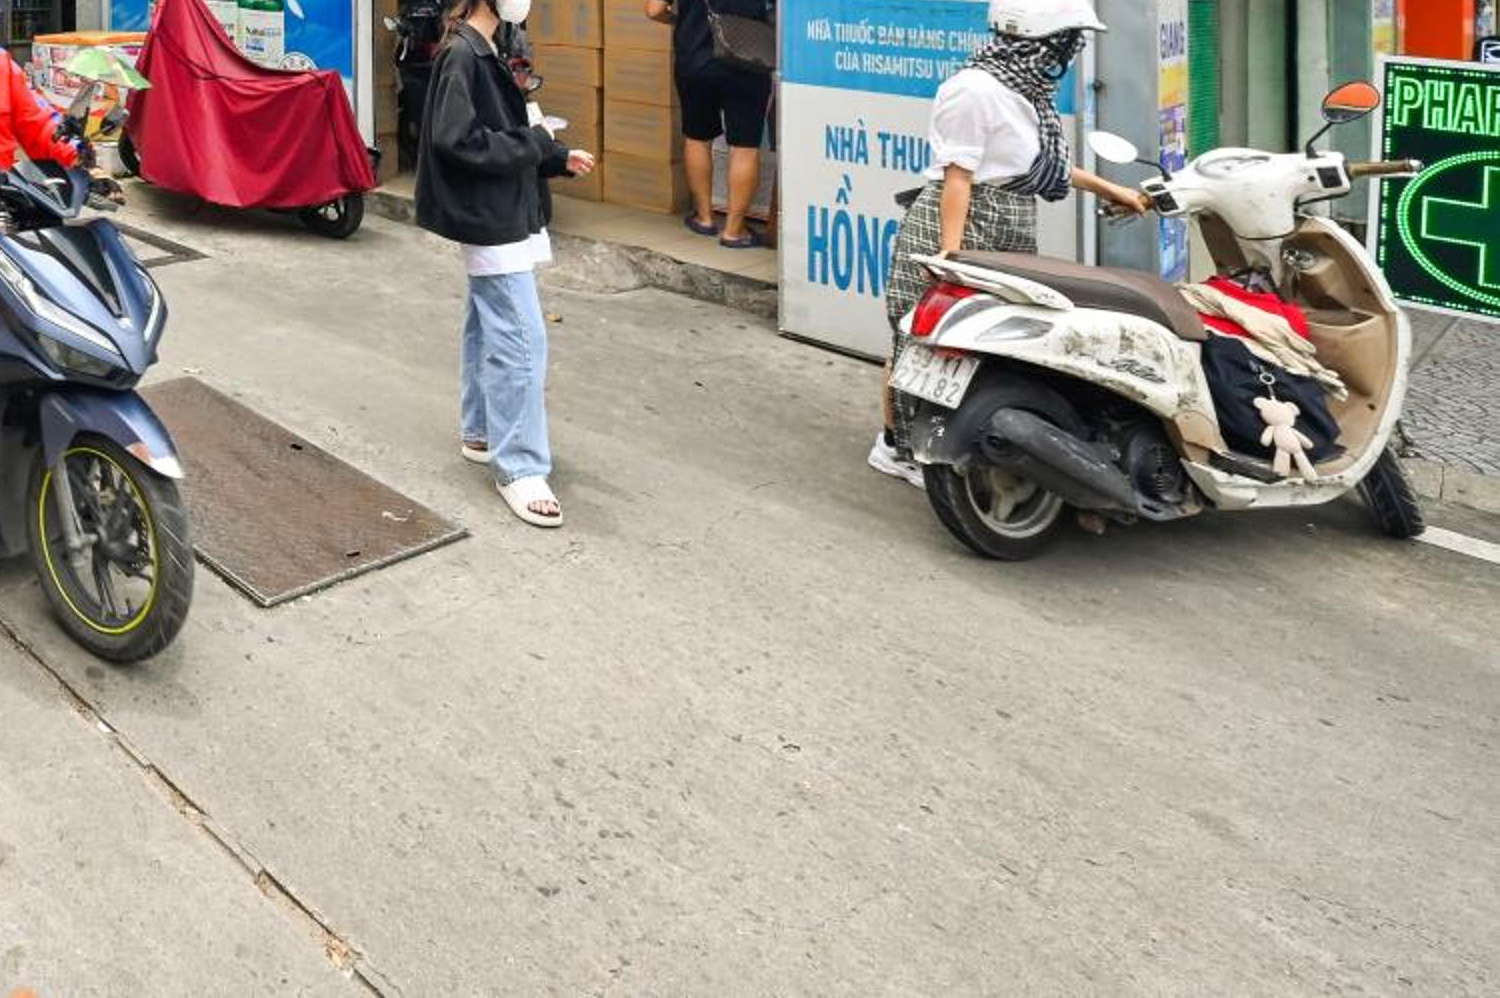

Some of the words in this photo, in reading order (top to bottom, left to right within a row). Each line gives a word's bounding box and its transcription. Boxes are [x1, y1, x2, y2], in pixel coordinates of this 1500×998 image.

[807, 18, 831, 41] NHÀ
[834, 18, 876, 45] THUỐC
[878, 23, 904, 47] BÁN
[907, 23, 946, 50] HÀNG
[835, 47, 859, 72] CỦA
[862, 53, 933, 79] HISAMITSU
[826, 118, 869, 165] NHÀ
